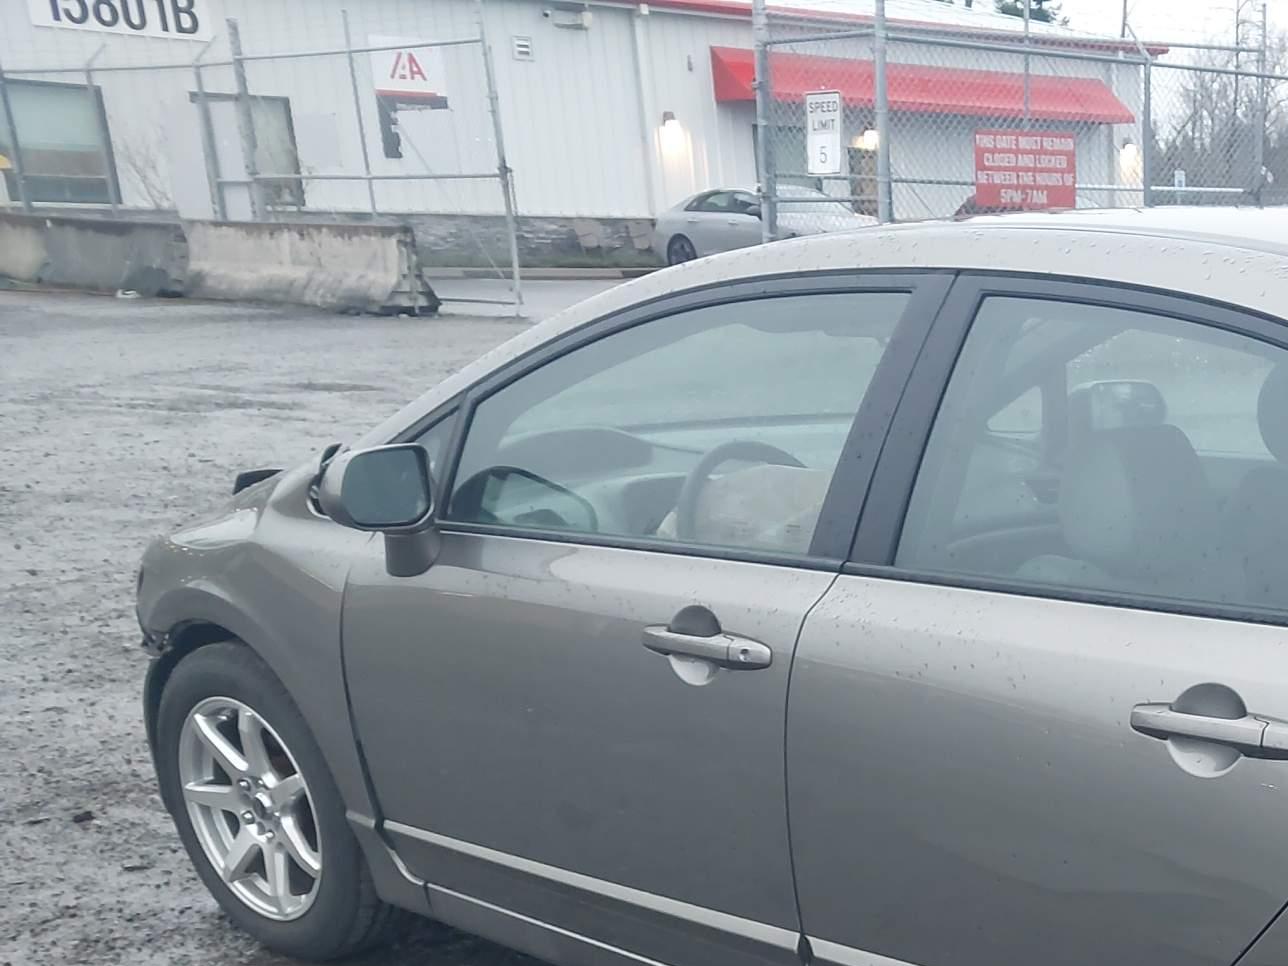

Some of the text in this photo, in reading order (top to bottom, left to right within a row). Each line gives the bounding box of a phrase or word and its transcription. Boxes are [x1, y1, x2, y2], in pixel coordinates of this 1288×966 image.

[809, 101, 838, 114] SPEED
[812, 119, 835, 132] LIMIT
[976, 134, 1074, 151] THIS GATE MUST REMAIN
[819, 146, 828, 164] 5
[984, 153, 1067, 169] CLOSED AND LOCKED
[977, 171, 1075, 186] BETWEEN THE HOURS OF
[1000, 189, 1047, 204] 5PM-7AM
